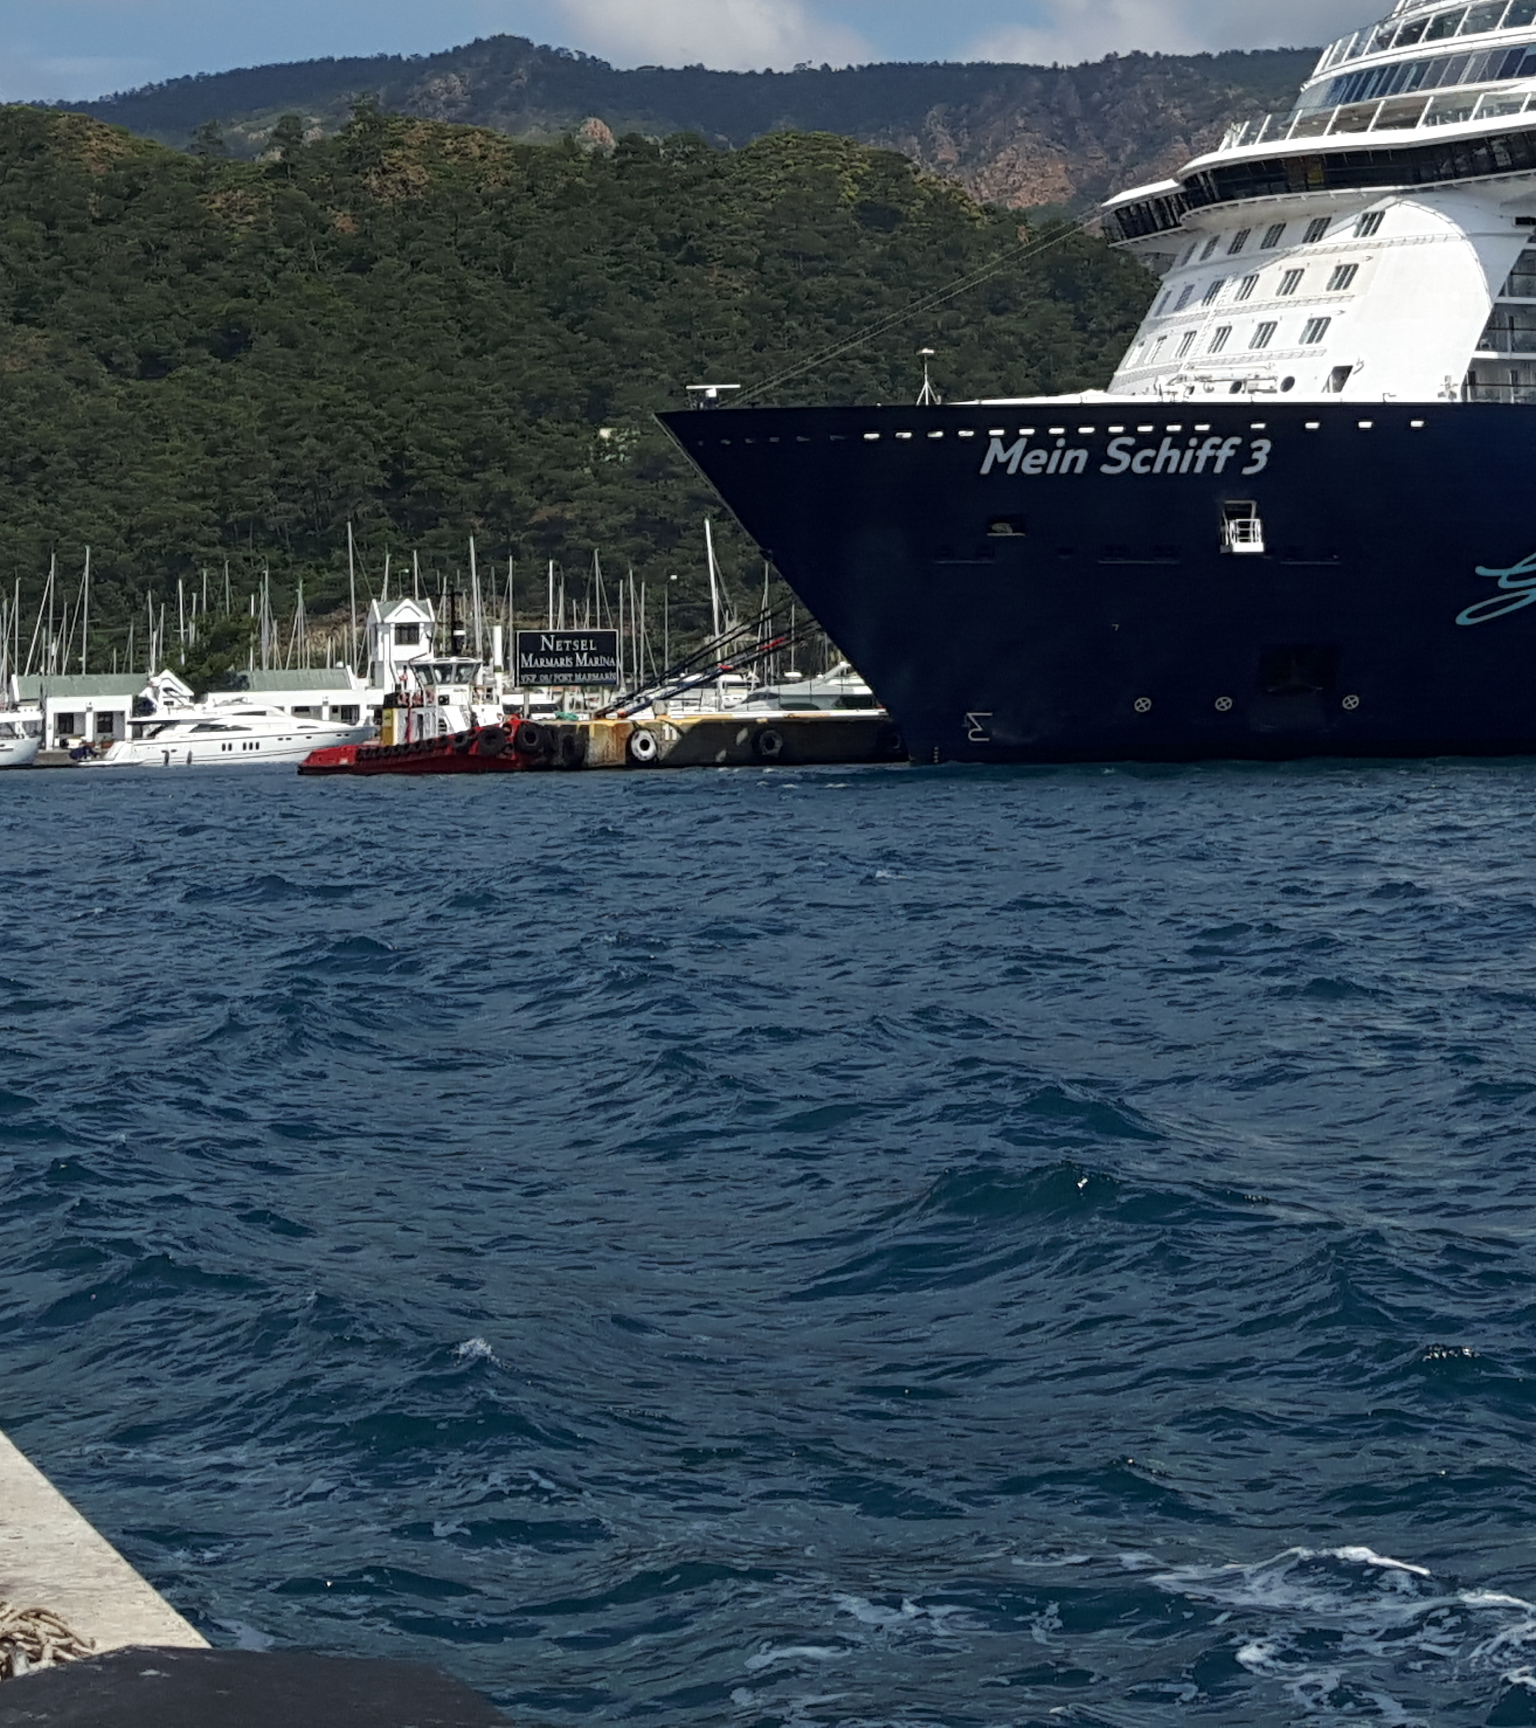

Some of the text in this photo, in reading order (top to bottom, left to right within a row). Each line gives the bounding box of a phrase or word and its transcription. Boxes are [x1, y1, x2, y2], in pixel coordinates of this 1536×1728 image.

[979, 436, 1272, 475] Mein Schiff 3
